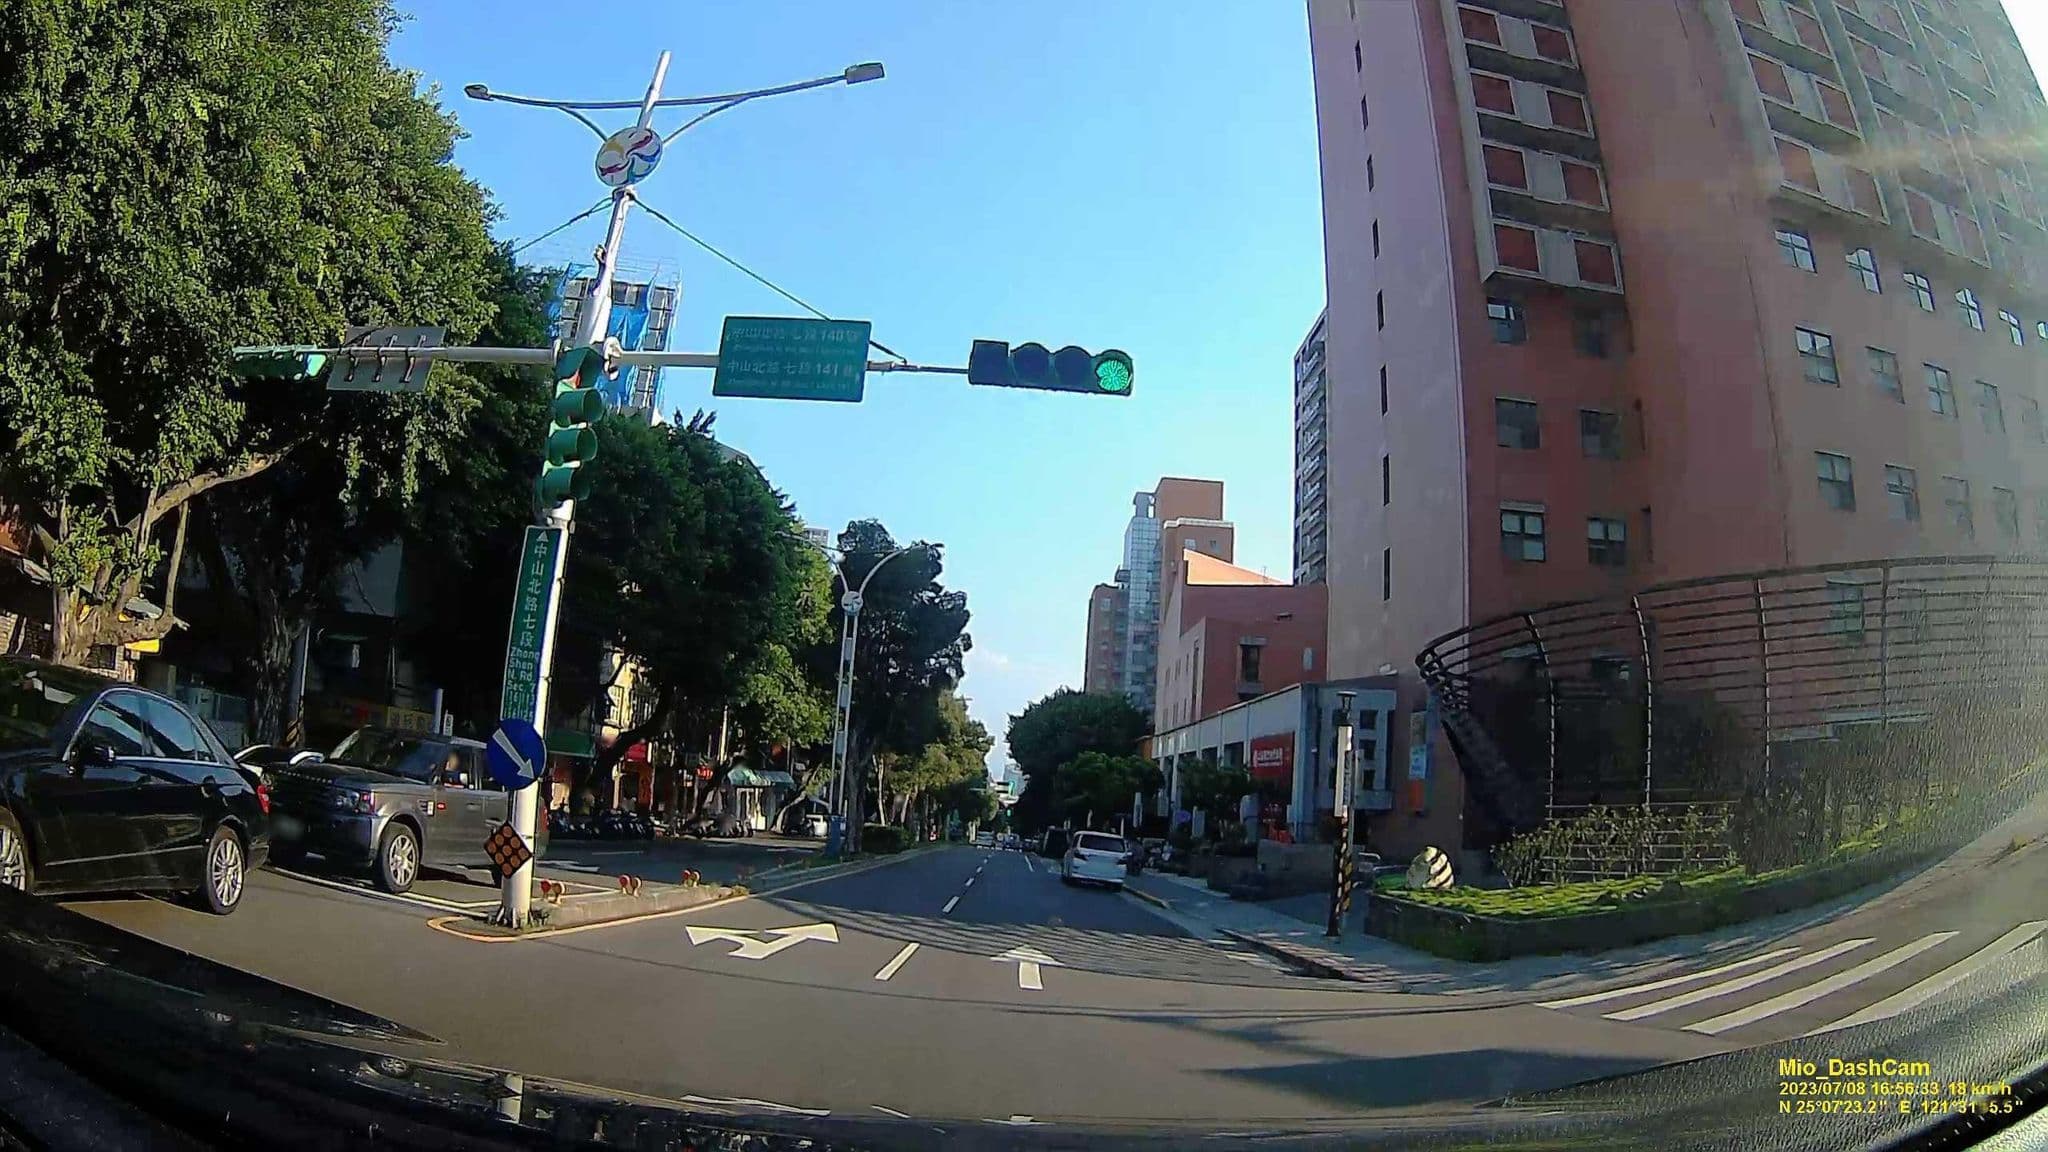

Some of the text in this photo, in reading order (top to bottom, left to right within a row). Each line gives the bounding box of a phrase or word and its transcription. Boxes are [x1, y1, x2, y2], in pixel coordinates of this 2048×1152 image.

[520, 543, 547, 647] 中山北路七段
[511, 646, 540, 663] Zhong
